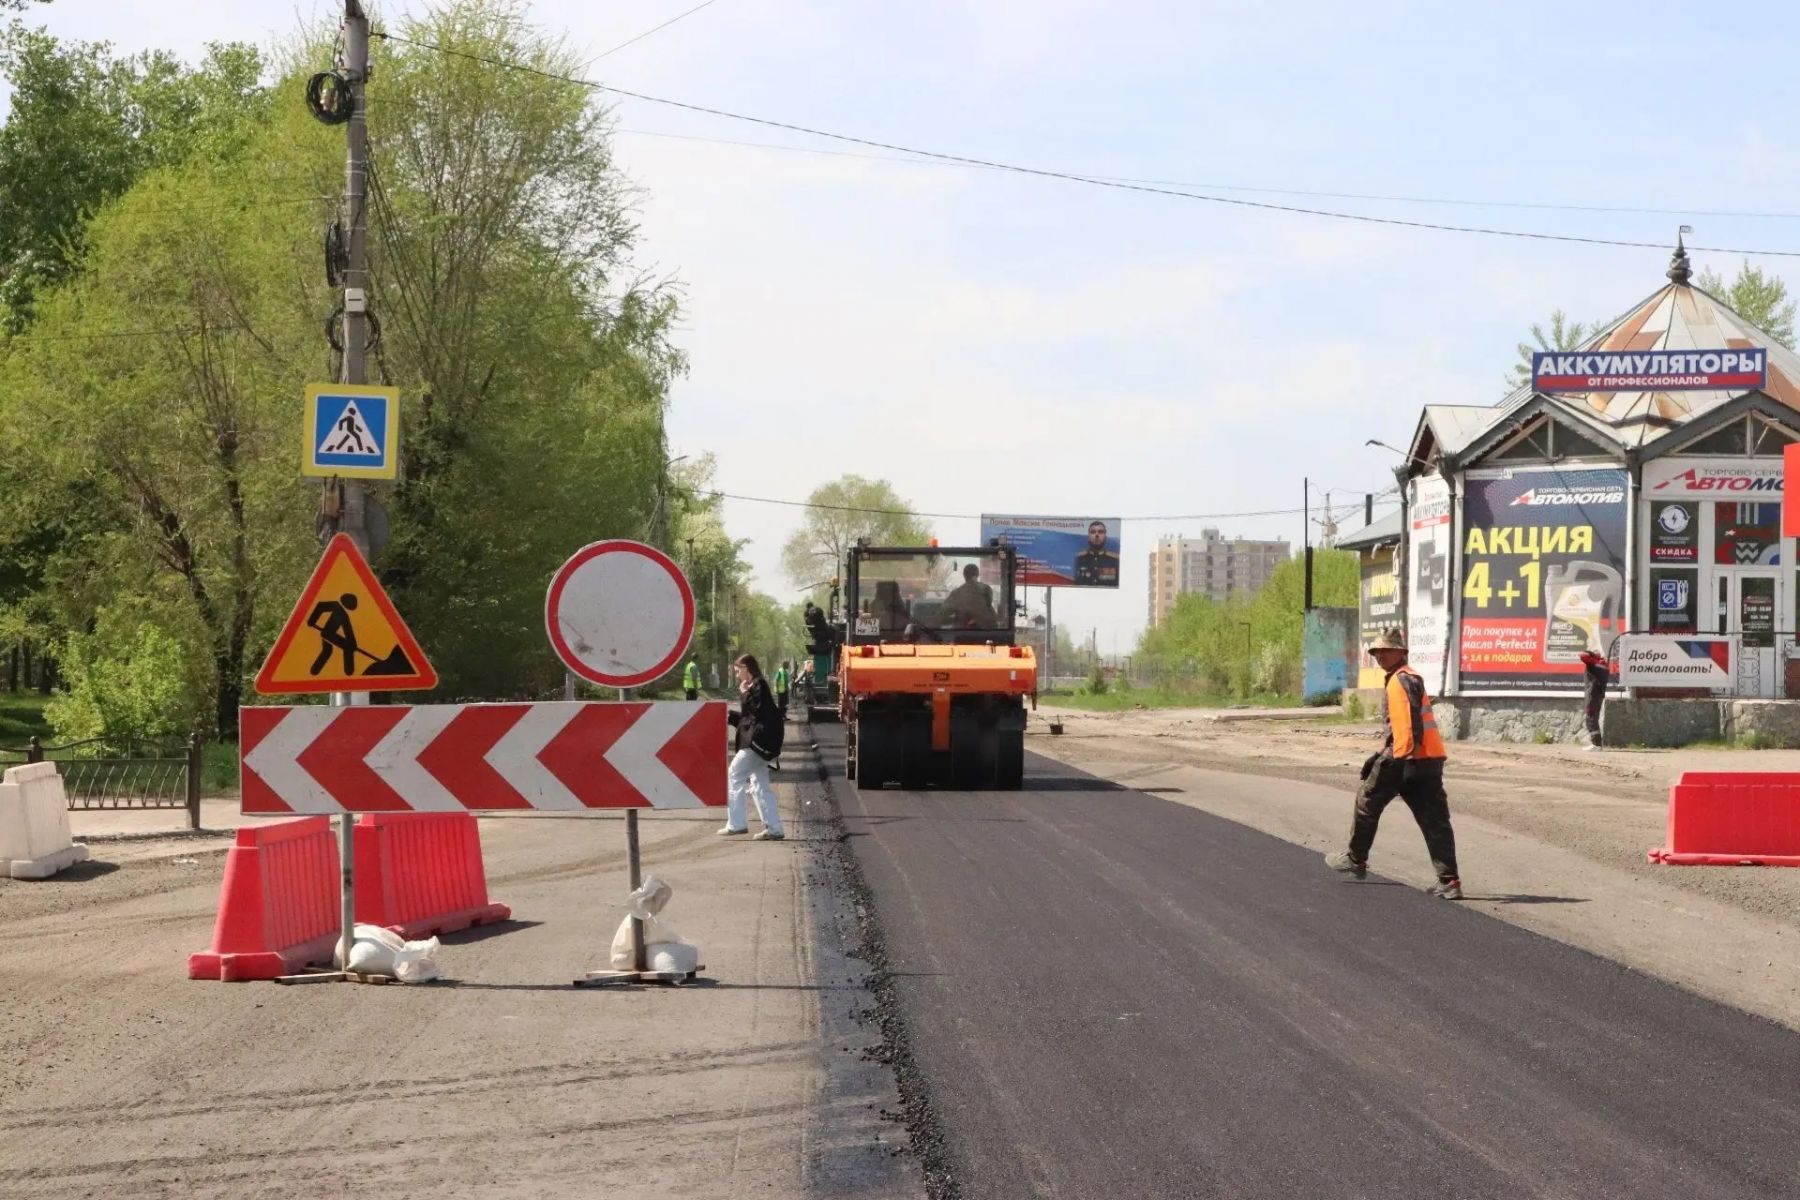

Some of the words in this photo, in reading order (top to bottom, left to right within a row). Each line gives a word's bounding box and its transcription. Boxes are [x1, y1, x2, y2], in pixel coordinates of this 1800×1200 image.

[1536, 352, 1763, 376] АККУМУЛЯТОРЫ
[1588, 377, 1601, 387] ОТ
[1604, 375, 1709, 387] ПРОФЕССИОНАЛОВ
[1704, 468, 1784, 476] ТОРГОВО-СЕРВ
[1464, 525, 1593, 561] АКЦИЯ
[1655, 548, 1692, 556] СКИДКА
[1463, 561, 1540, 608] 4+1
[1463, 625, 1482, 638] При
[1484, 627, 1523, 639] покупке
[1495, 638, 1537, 649] Perfectis
[1491, 651, 1533, 664] подарок
[1629, 650, 1668, 661] Добро
[1629, 664, 1713, 673] пожаловать!
